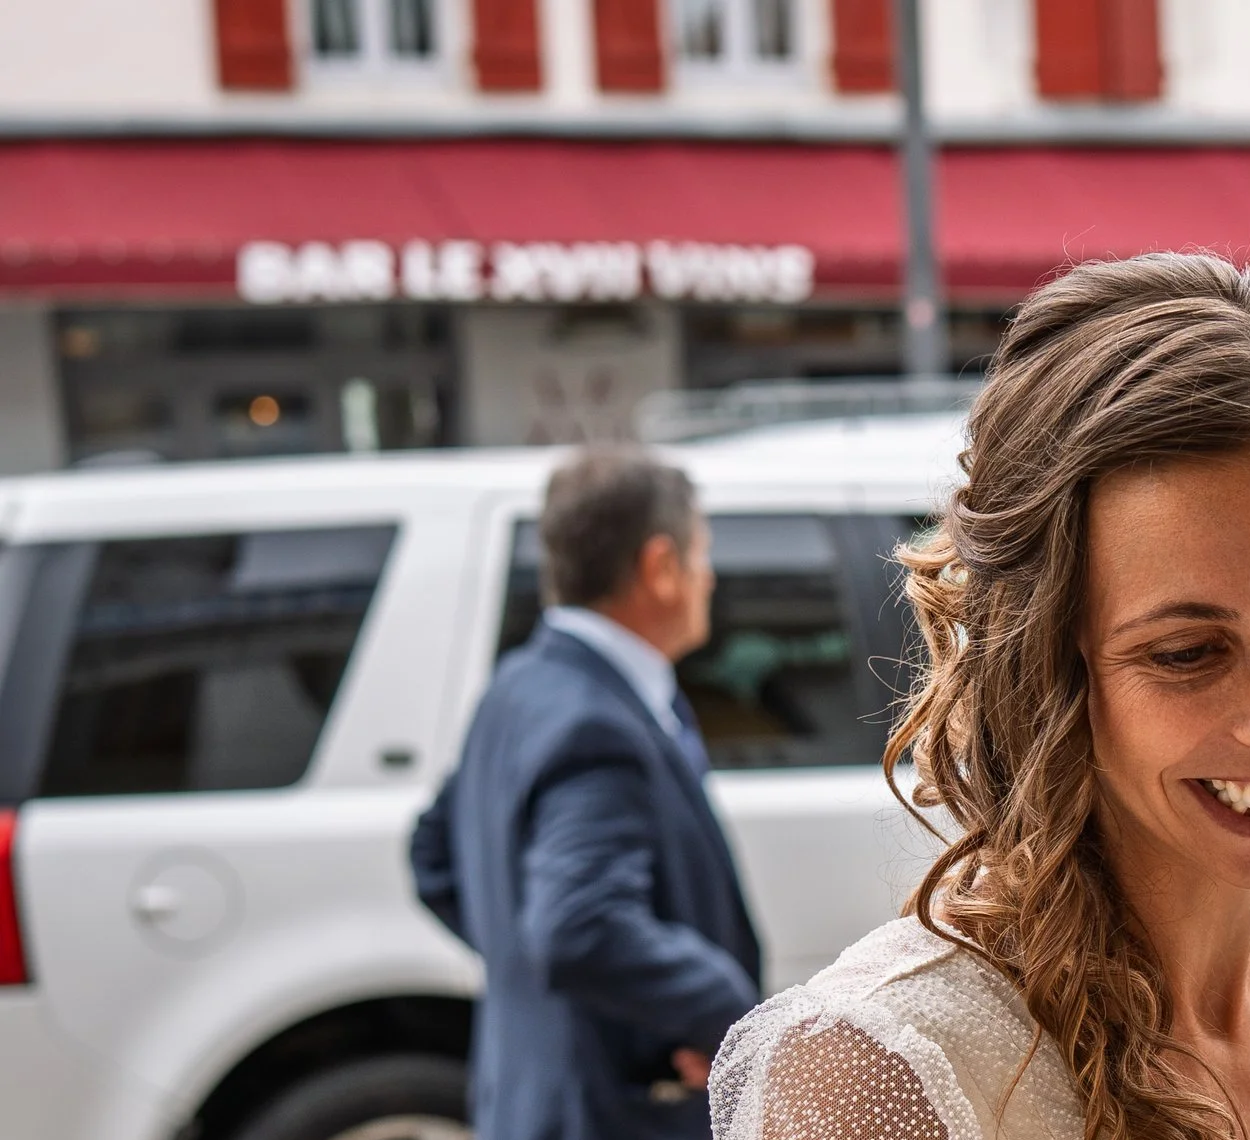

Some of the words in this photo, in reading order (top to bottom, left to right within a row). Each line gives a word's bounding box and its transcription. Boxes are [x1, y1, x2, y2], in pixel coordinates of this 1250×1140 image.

[238, 240, 394, 303] BAR
[403, 239, 483, 301] LE
[646, 240, 814, 303] VINS
